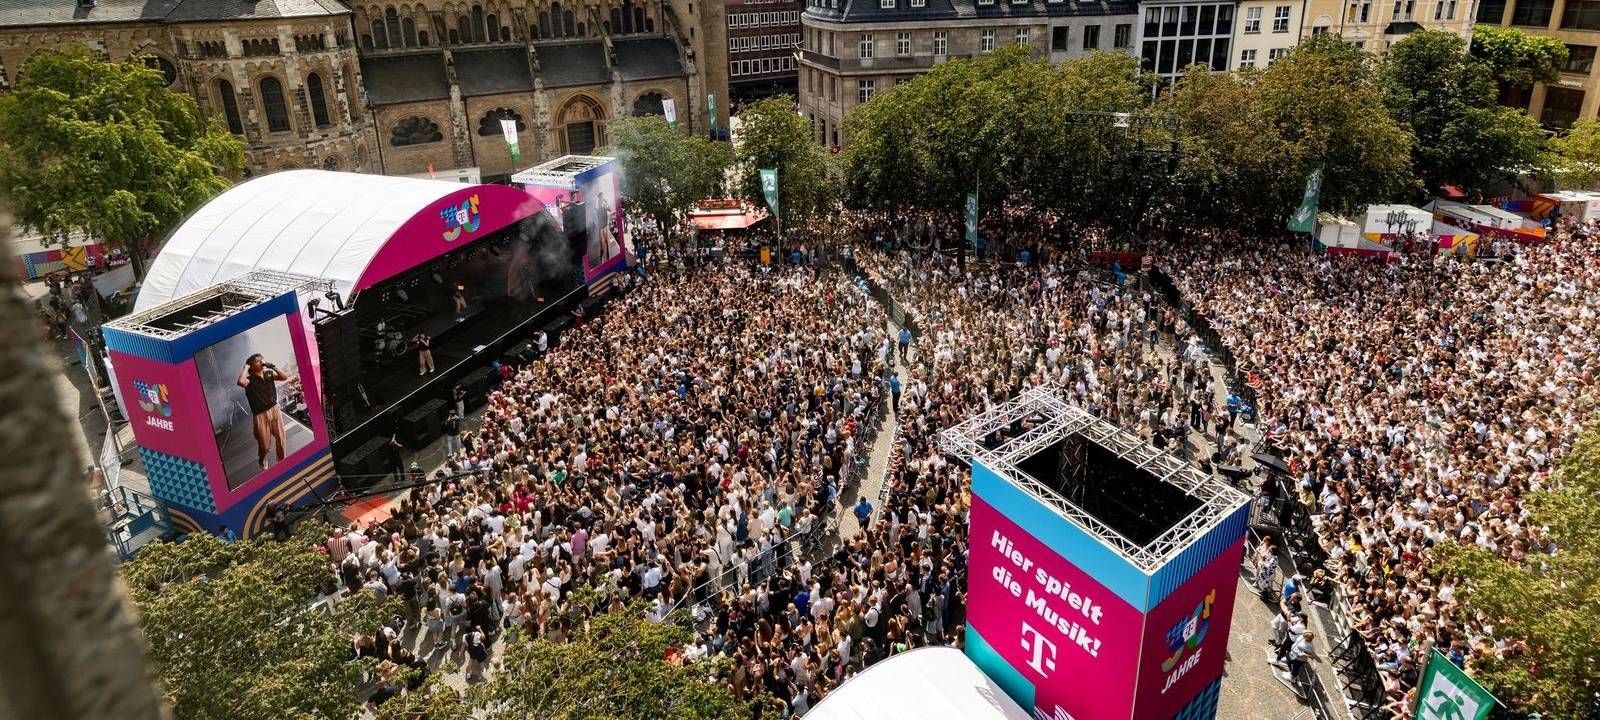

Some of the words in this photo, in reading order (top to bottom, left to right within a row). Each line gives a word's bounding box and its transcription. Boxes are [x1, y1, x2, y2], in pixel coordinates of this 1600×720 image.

[146, 416, 174, 431] JAHRE
[991, 529, 1034, 573] Hier
[1035, 568, 1103, 626] spielt
[992, 566, 1022, 597] die
[1025, 588, 1101, 658] Musik!
[1020, 620, 1057, 679] T
[1161, 647, 1202, 695] JAHRE
